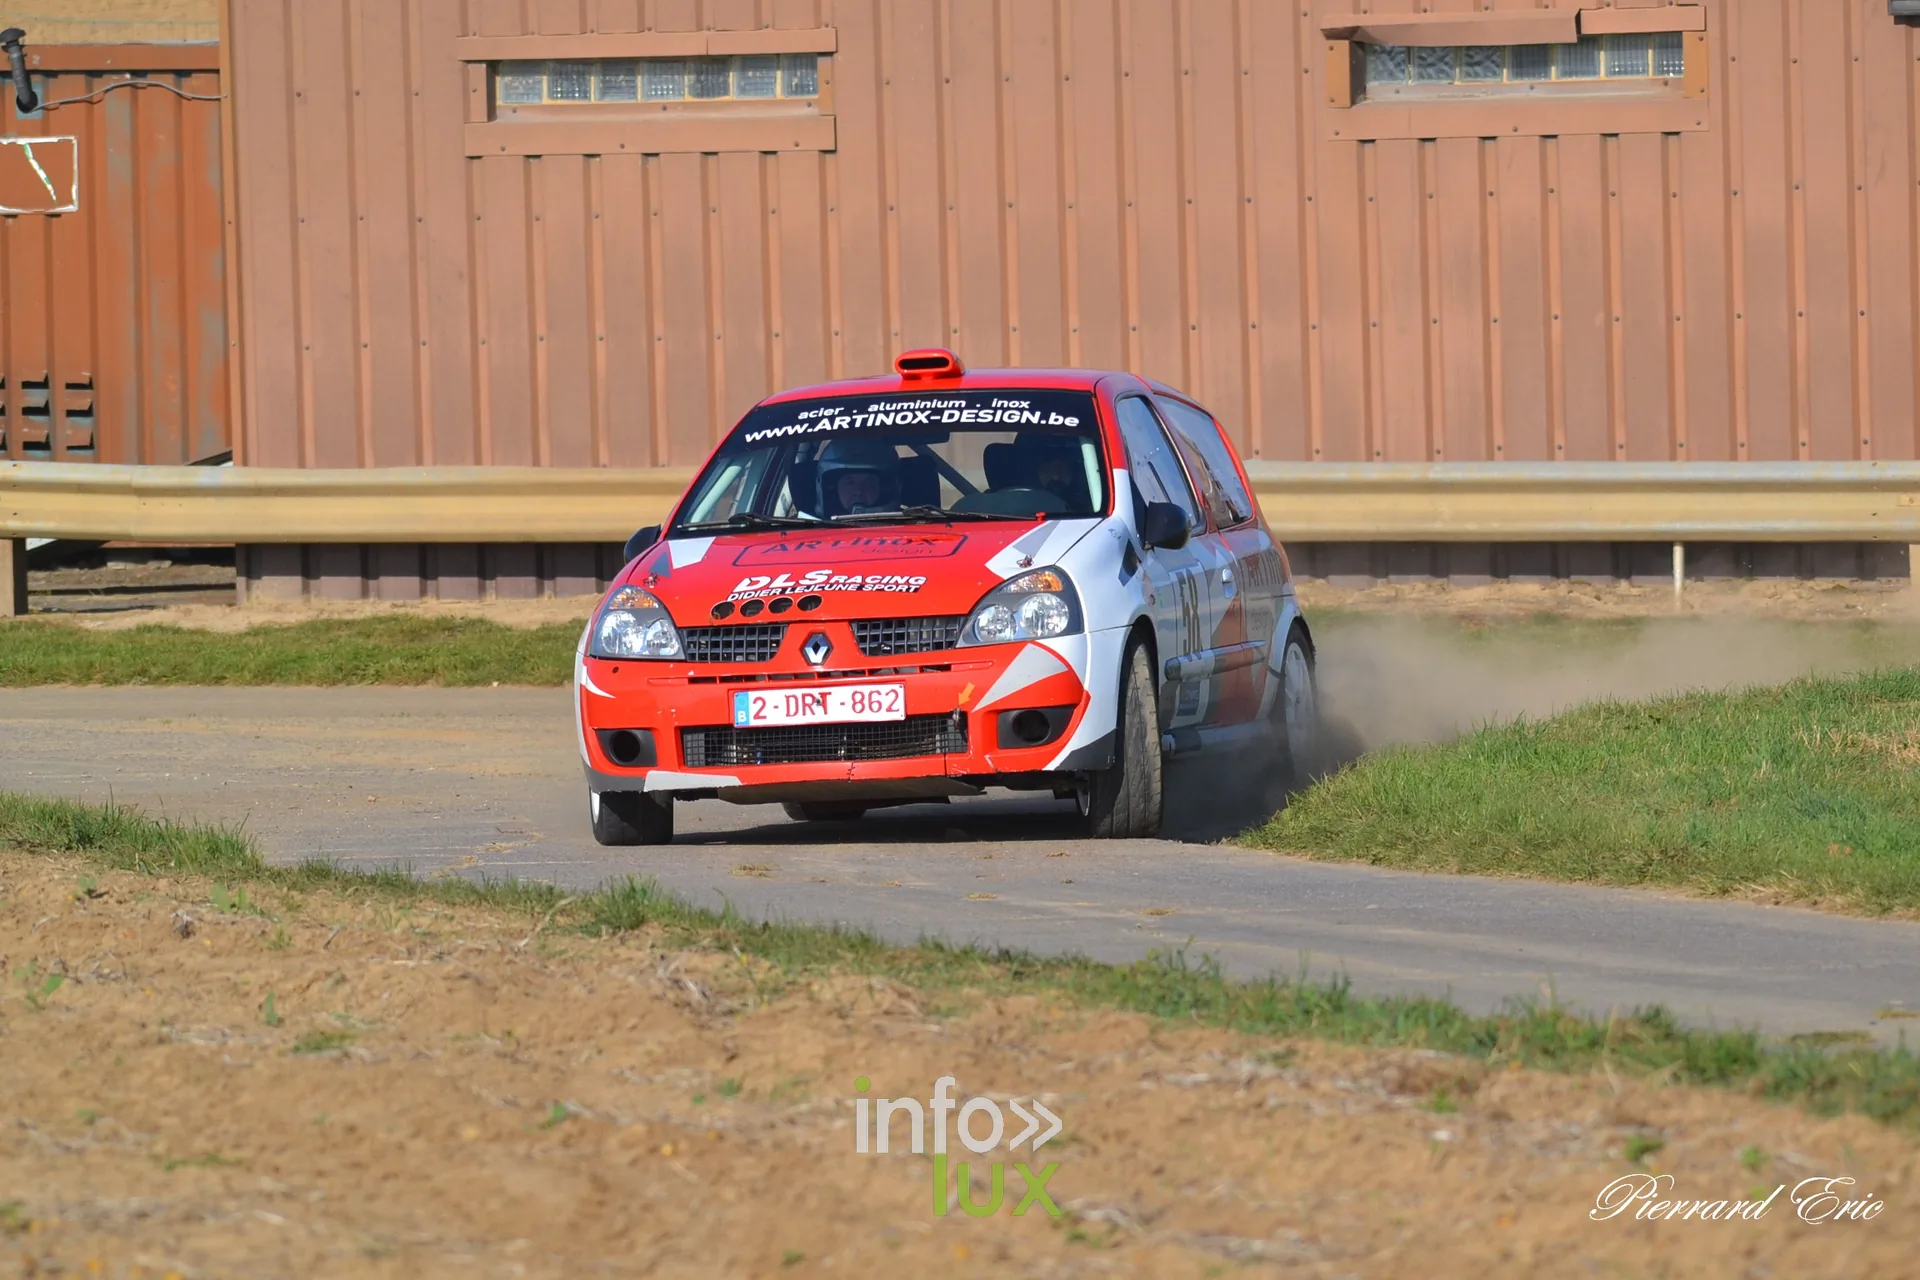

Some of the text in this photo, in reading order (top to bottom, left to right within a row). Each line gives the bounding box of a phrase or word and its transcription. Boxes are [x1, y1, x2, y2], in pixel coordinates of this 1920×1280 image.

[798, 398, 1031, 420] acier aluminium inox
[745, 409, 1079, 442] www.ARTINOX-DESIGN.be
[727, 587, 782, 602] DIDIER
[862, 583, 920, 593] SPORT
[732, 569, 927, 593] DLS RACING
[737, 688, 900, 722] B 2-DRT-862
